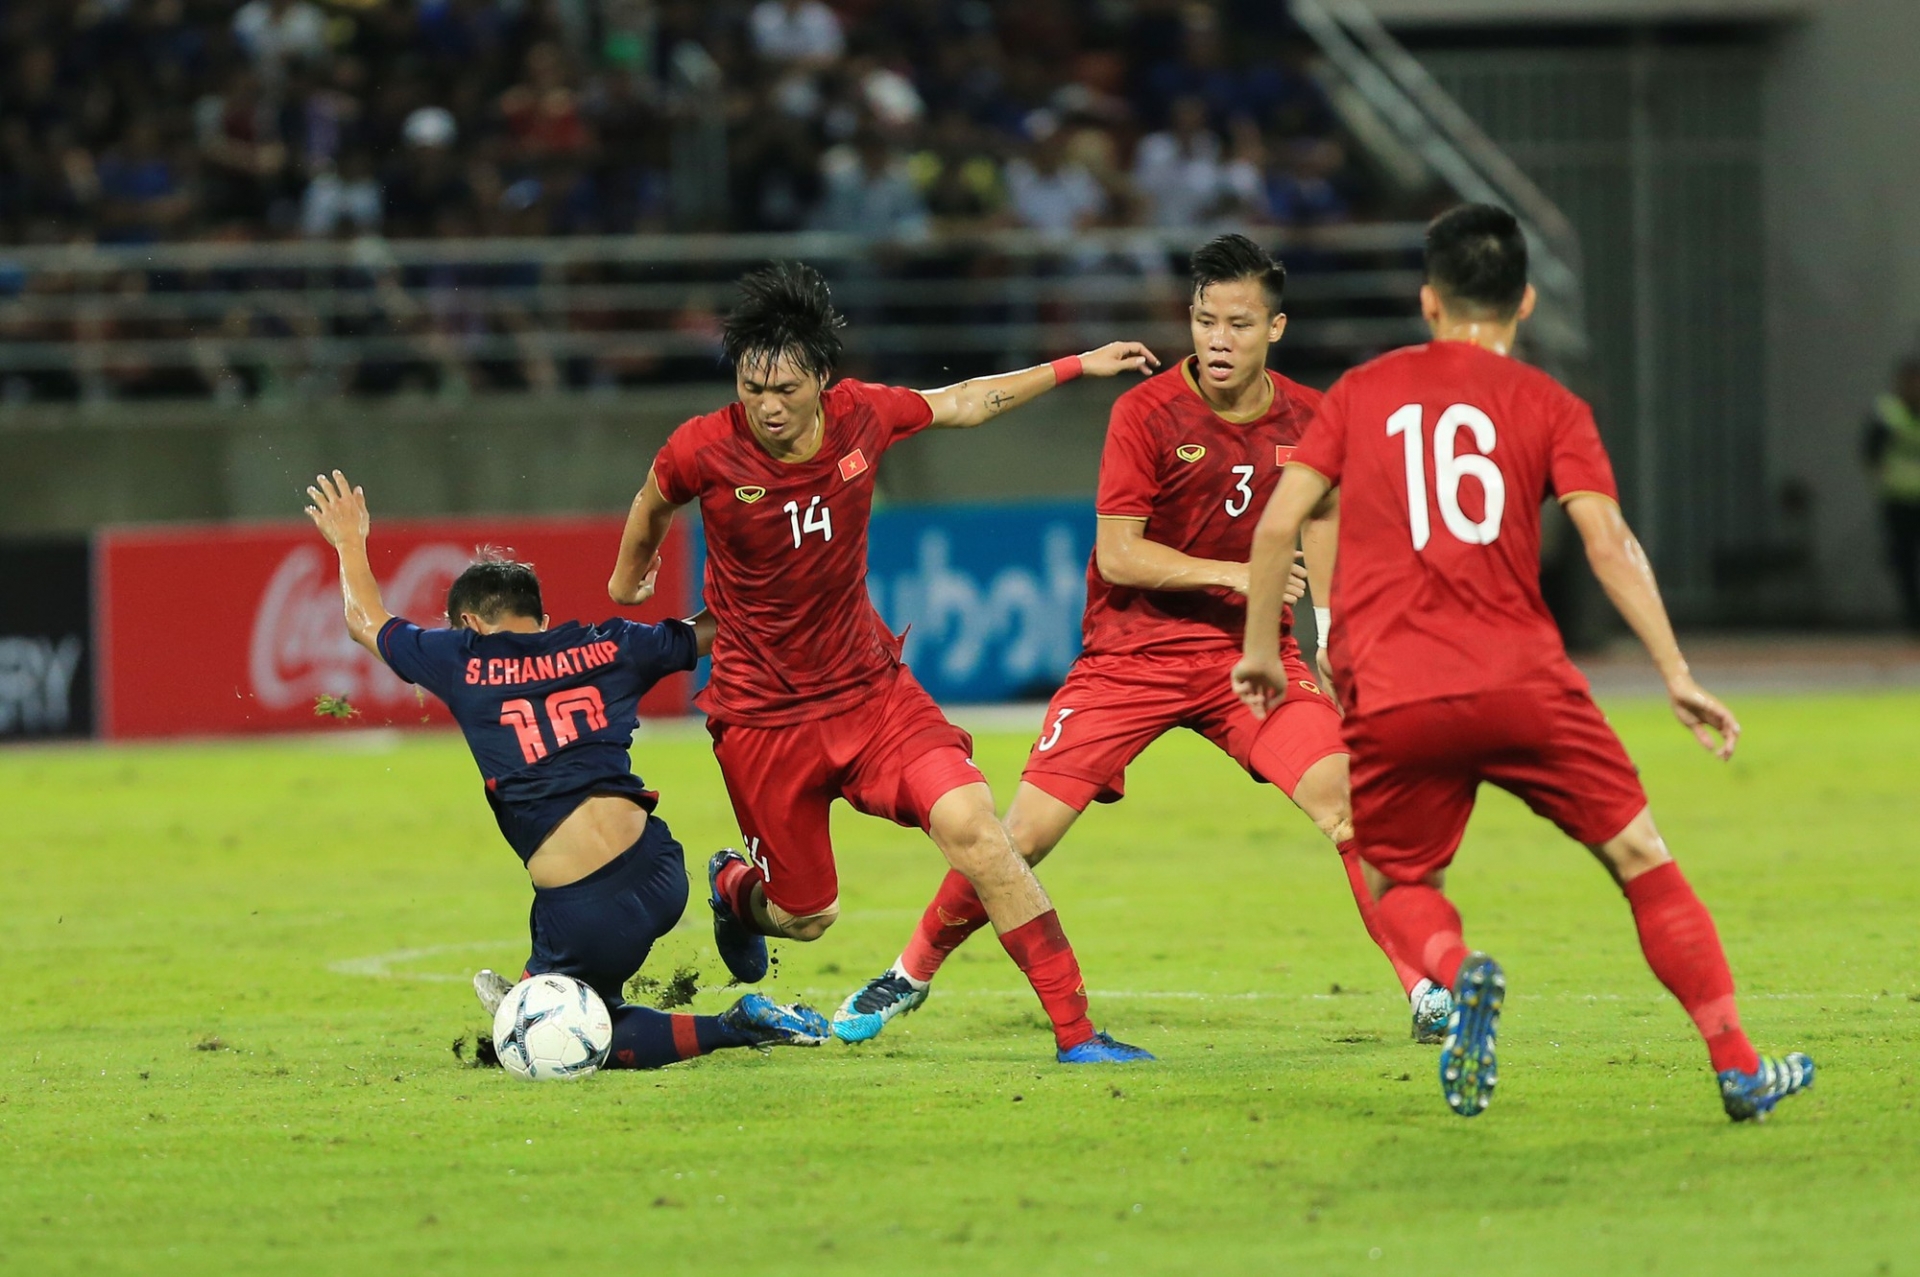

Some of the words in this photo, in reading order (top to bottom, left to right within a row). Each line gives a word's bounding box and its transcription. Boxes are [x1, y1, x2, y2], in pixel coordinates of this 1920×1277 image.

[1225, 465, 1254, 518] 3
[1386, 402, 1506, 551] 16
[783, 495, 832, 549] 14
[465, 640, 619, 685] S.CHANATHIP
[500, 685, 609, 764] 10
[1038, 708, 1075, 752] 3
